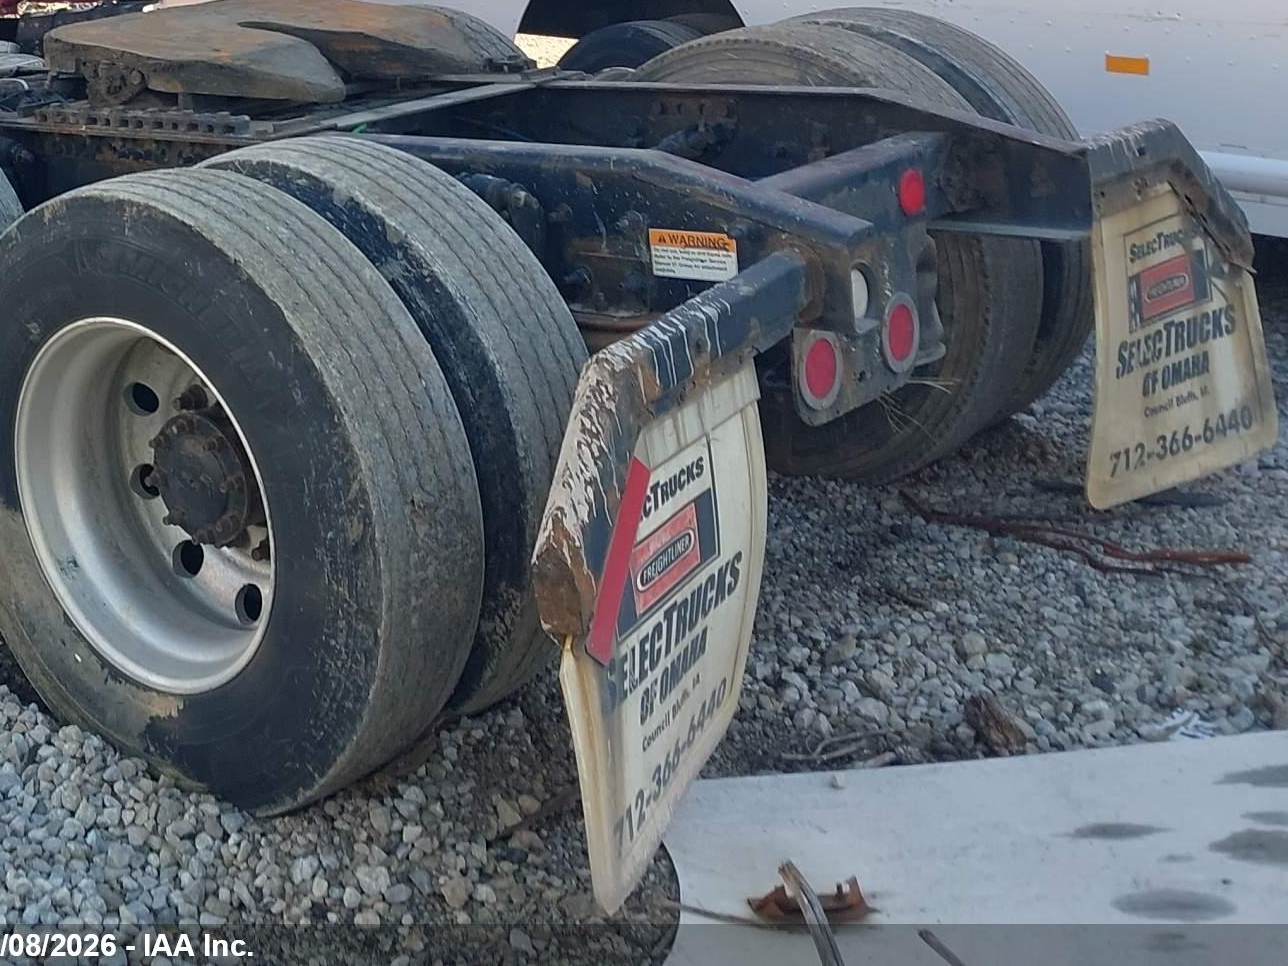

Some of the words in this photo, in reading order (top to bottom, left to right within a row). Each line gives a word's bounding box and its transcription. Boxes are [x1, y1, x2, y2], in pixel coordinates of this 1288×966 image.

[669, 234, 729, 251] WARNING
[1142, 369, 1159, 397] OF
[1162, 350, 1210, 391] OMAHA
[1110, 404, 1253, 477] 712-366-6440
[643, 535, 690, 583] FREIGHTLINER
[614, 677, 727, 859] 712-366-6440
